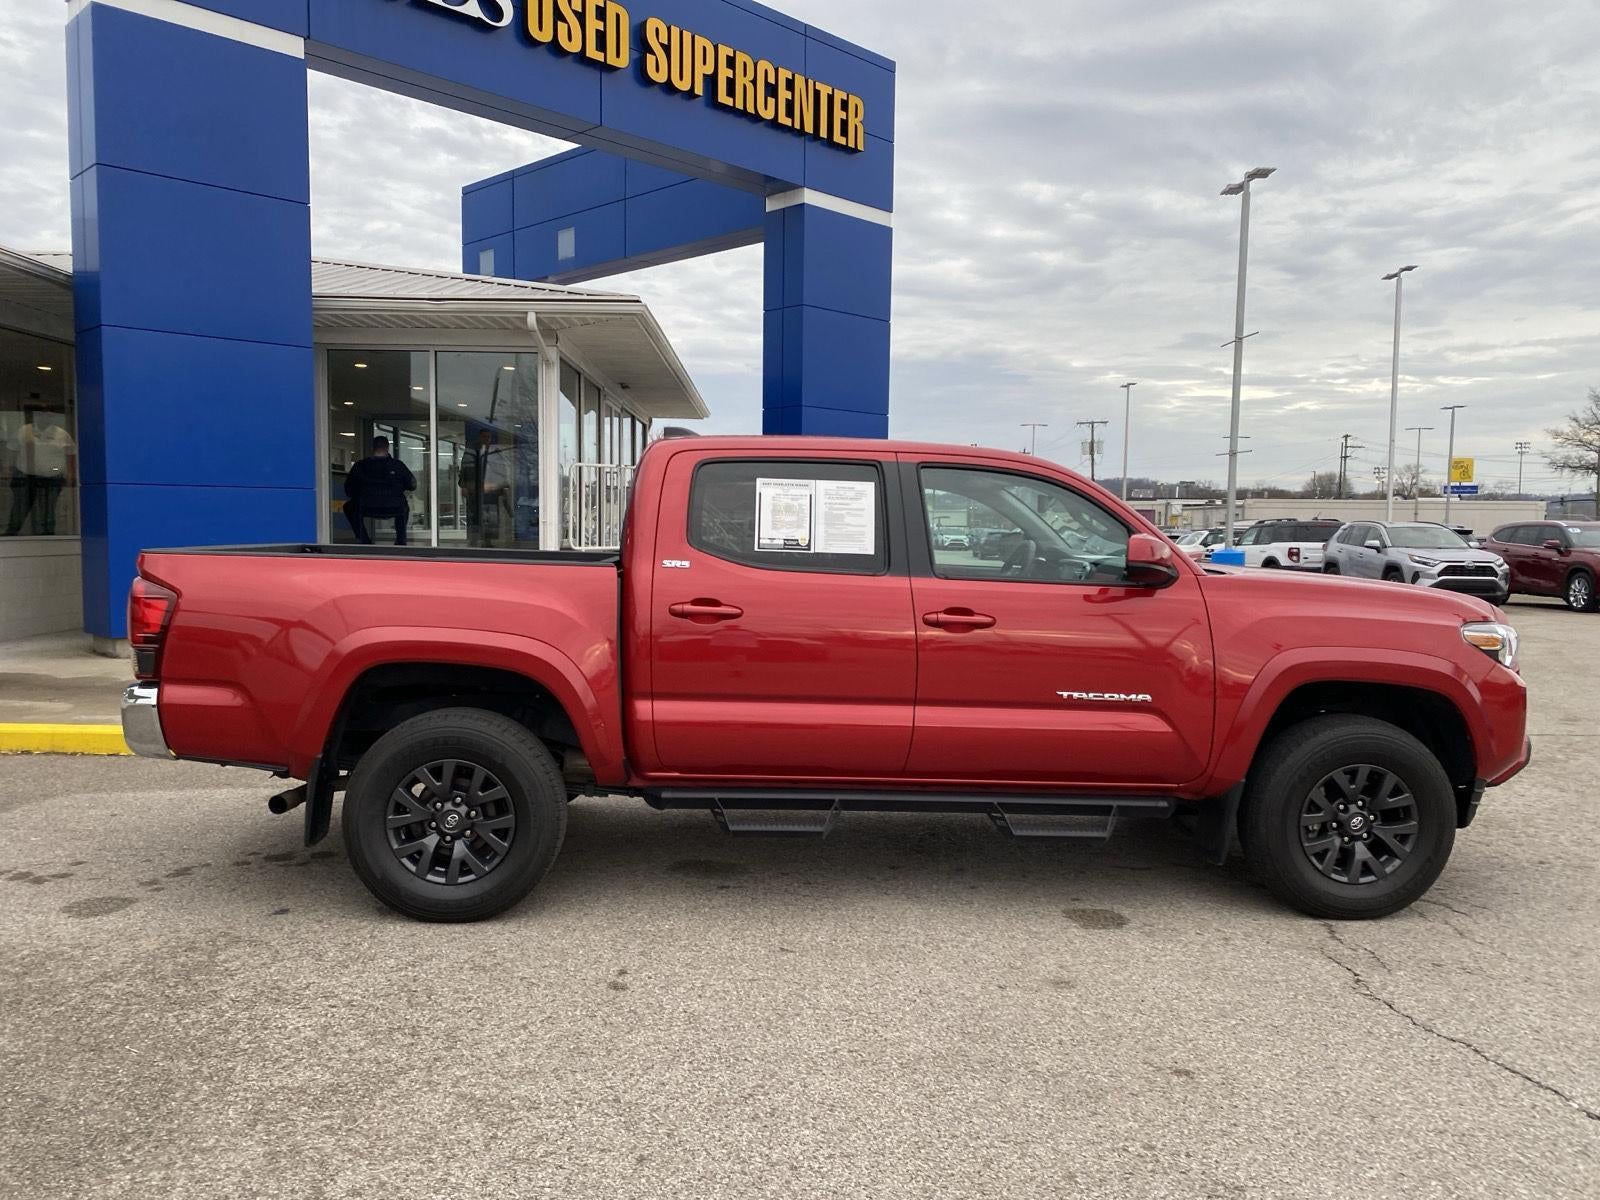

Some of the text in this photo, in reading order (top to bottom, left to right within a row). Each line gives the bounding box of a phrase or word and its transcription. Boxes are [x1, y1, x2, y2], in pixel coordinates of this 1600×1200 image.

[526, 0, 865, 152] USED SUPERCENTER
[1056, 691, 1152, 702] TACOMA
